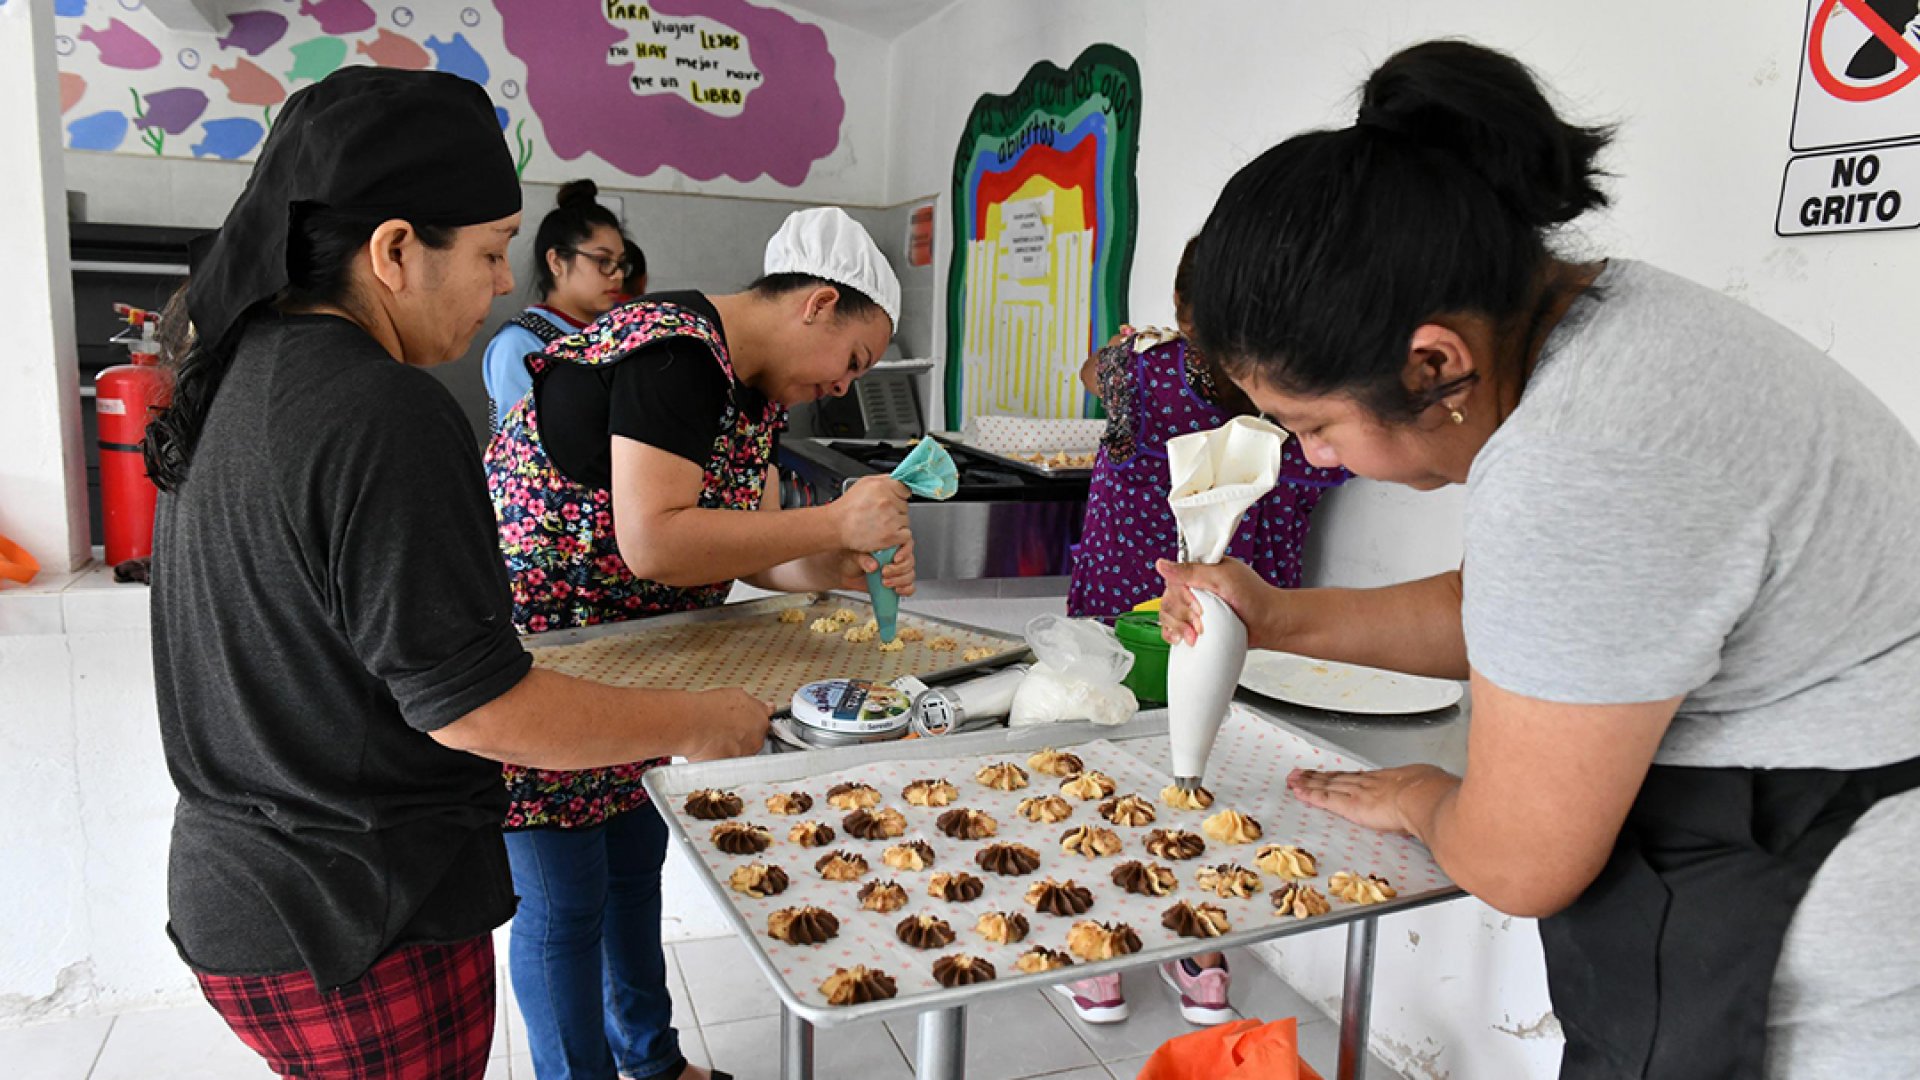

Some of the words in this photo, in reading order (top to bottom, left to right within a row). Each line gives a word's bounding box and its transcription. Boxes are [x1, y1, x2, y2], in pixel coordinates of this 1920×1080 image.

[607, 0, 649, 19] PARA
[609, 47, 628, 57] no
[636, 42, 667, 59] HAY
[675, 55, 718, 71] mejor
[726, 69, 760, 81] nave
[631, 75, 653, 90] que
[1831, 154, 1880, 189] NO
[1799, 190, 1901, 227] GRITO
